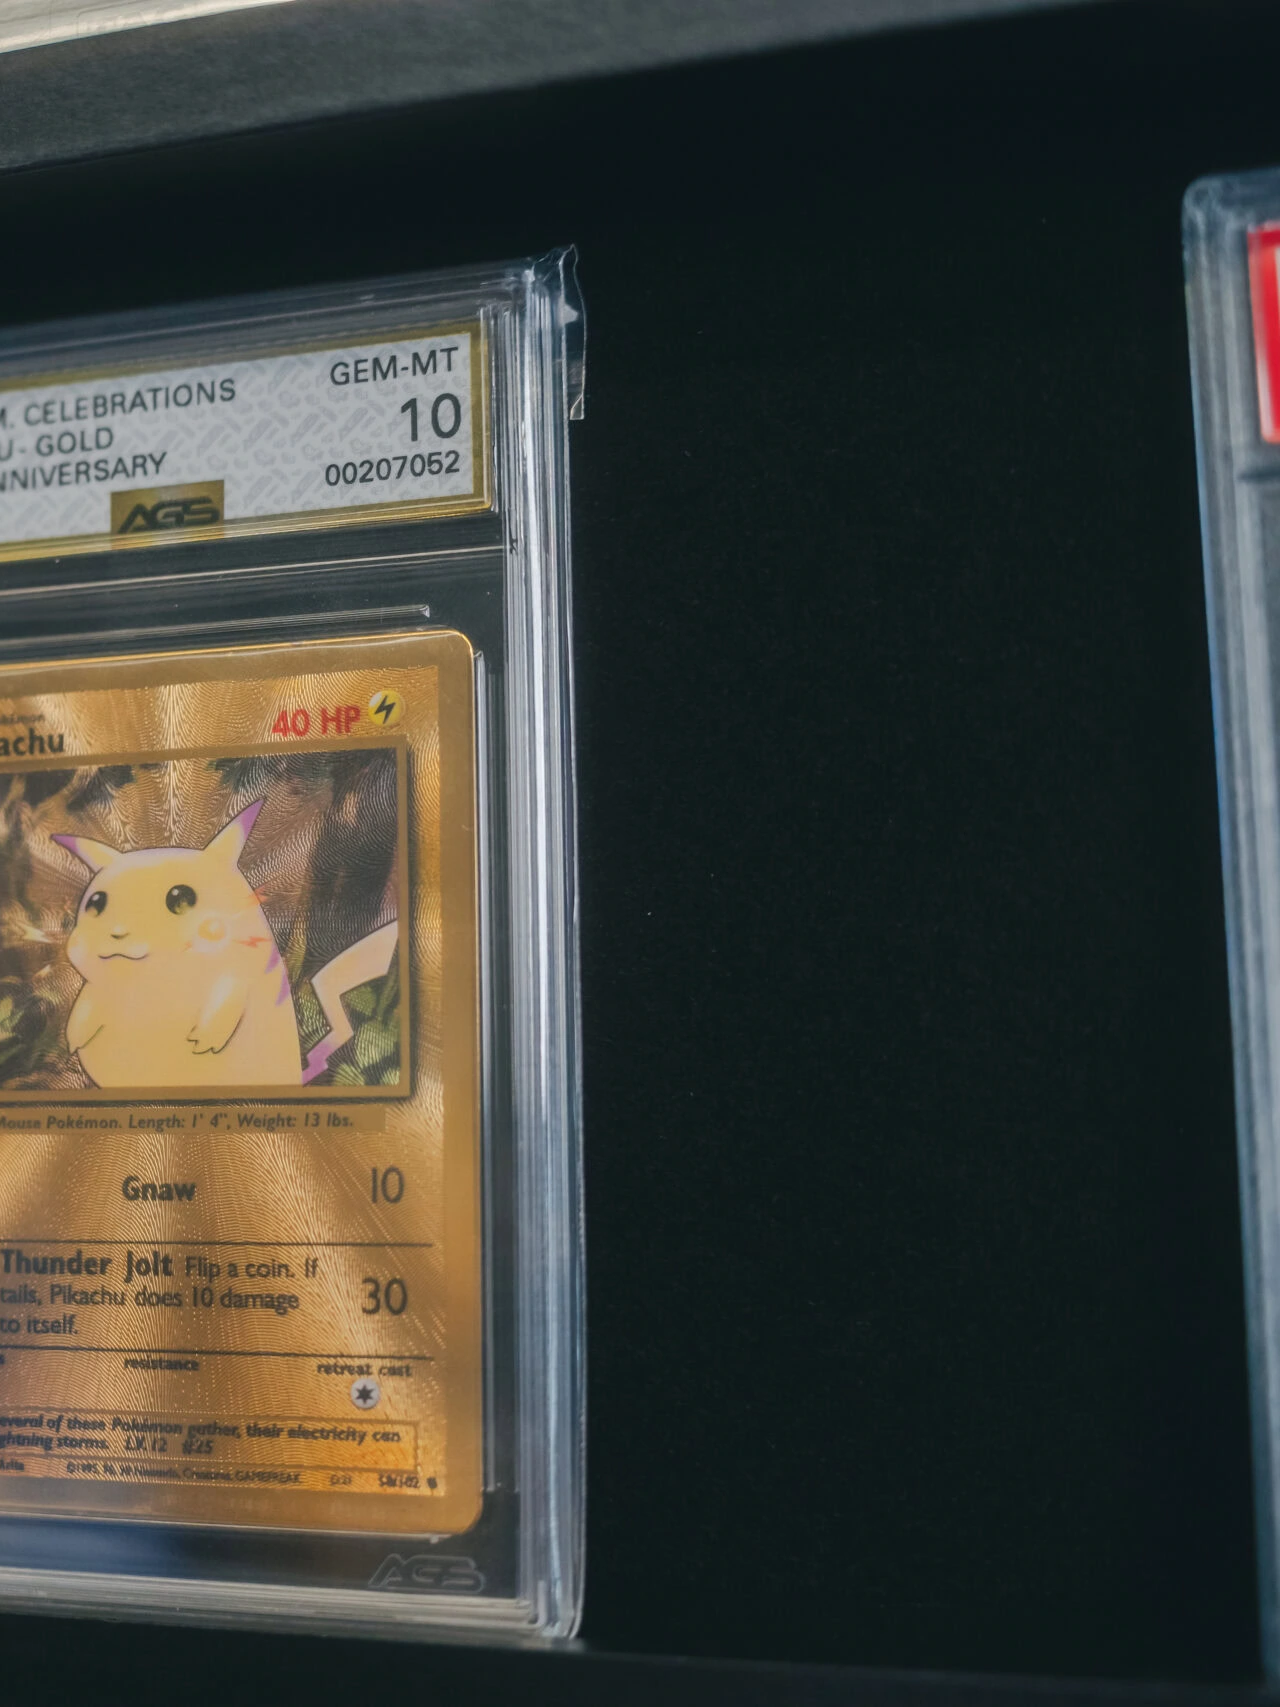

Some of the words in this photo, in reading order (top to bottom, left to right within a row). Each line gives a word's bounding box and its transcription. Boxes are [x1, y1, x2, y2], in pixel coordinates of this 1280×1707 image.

[329, 346, 459, 386] GEM-MT
[23, 378, 236, 426] CELEBRATIONS
[400, 392, 462, 442] 10
[35, 426, 114, 458] GOLD
[324, 450, 461, 487] 00207052
[119, 496, 220, 534] AGS
[271, 709, 311, 737] 40
[320, 705, 361, 735] HP
[46, 1114, 122, 1130] Pokémon.
[128, 1113, 185, 1132] Length:
[237, 1113, 297, 1133] Weight:
[304, 1113, 320, 1128] 13
[327, 1112, 354, 1128] lbs.
[121, 1174, 196, 1202] Gnaw
[371, 1166, 405, 1205] 10
[0, 1248, 112, 1276] Thunder
[124, 1250, 173, 1284] Jolt
[185, 1255, 220, 1283] Flip
[226, 1261, 238, 1278] a
[244, 1258, 296, 1279] coin.
[304, 1257, 320, 1279] If
[0, 1283, 42, 1306] tails,
[49, 1283, 126, 1307] Pikachu
[134, 1286, 183, 1308] does
[192, 1287, 214, 1309] 10
[220, 1287, 300, 1316] damage
[361, 1276, 409, 1316] 30
[0, 1315, 19, 1334] to
[26, 1311, 79, 1335] itself.
[123, 1355, 200, 1371] resistance
[317, 1362, 373, 1376] retreat
[377, 1363, 413, 1377] cost
[46, 1414, 64, 1432] of
[66, 1416, 106, 1431] these
[246, 1423, 285, 1439] their
[287, 1423, 367, 1446] electricity
[372, 1430, 402, 1443] can
